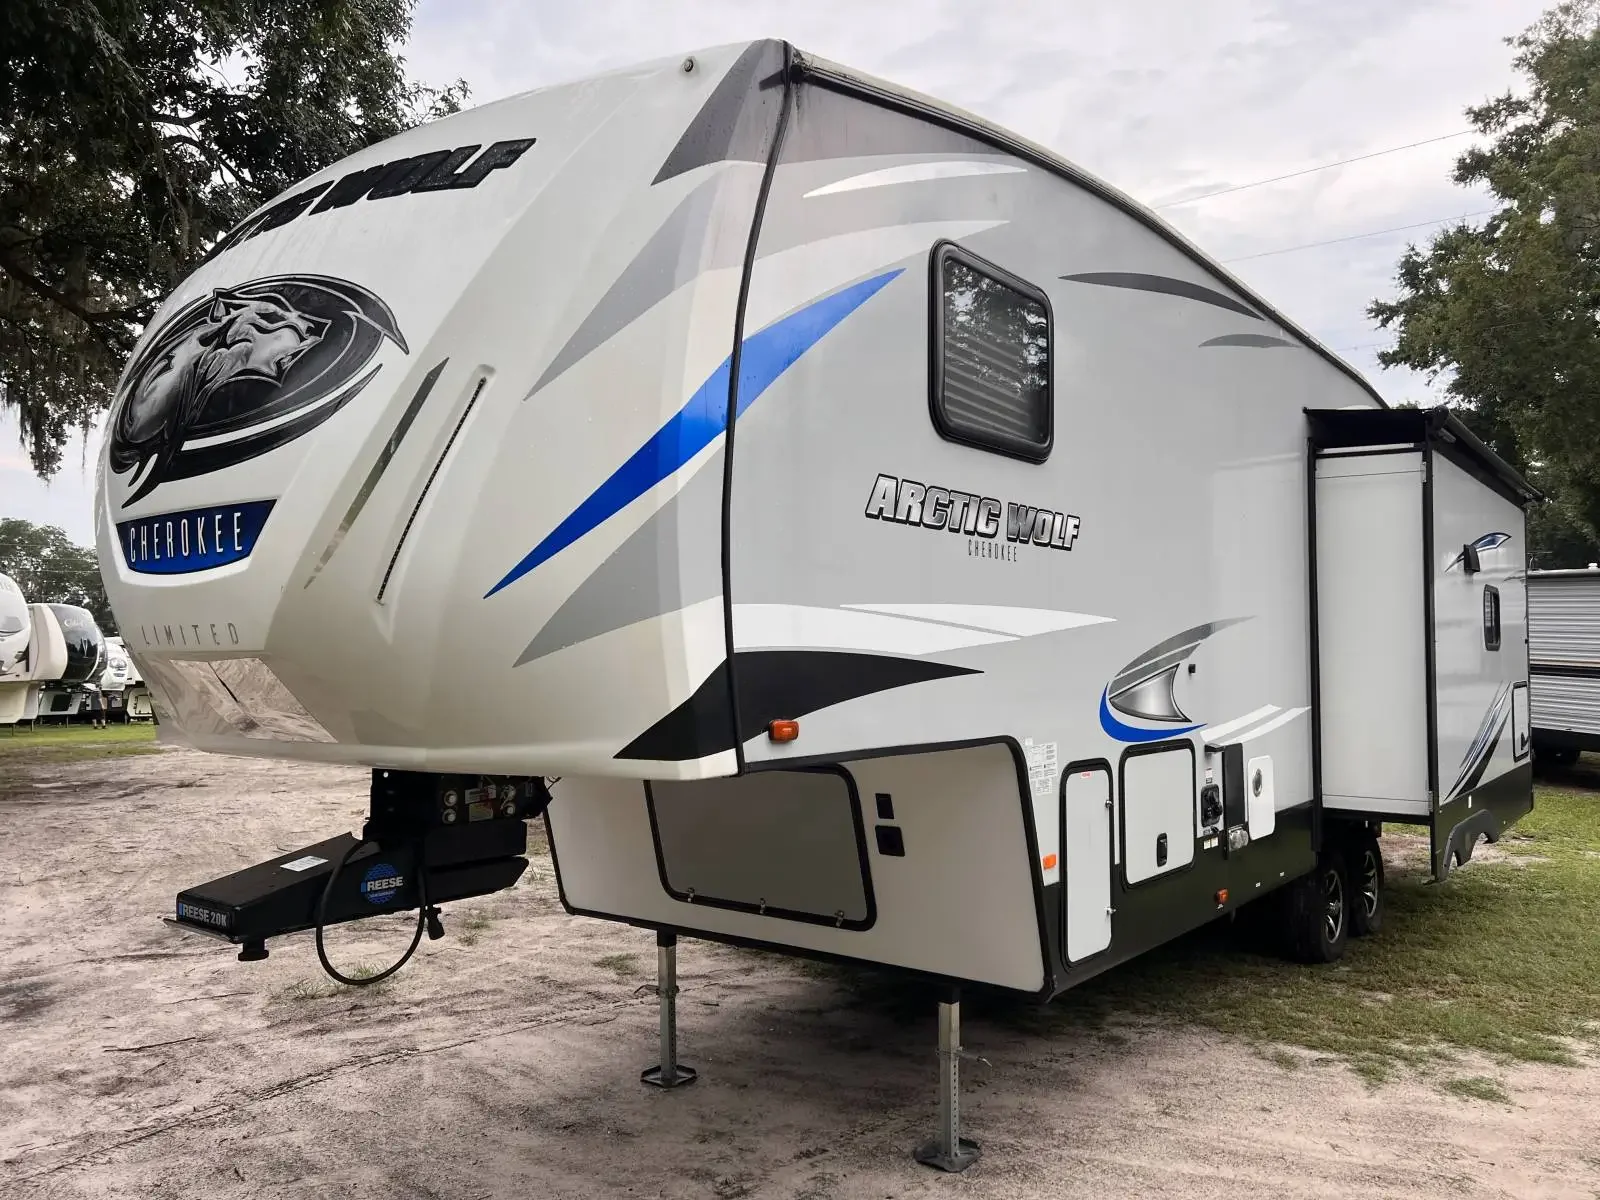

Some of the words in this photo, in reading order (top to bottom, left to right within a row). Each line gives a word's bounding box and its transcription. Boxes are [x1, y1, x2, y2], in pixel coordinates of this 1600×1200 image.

[865, 473, 1002, 539] ARCTIC
[1007, 501, 1081, 551] WOLF
[130, 512, 243, 563] CHEROKEE
[967, 539, 1018, 563] CHEROKEE
[141, 622, 240, 646] LIMITED
[367, 876, 404, 892] REESE
[182, 903, 210, 923] REESE
[210, 911, 228, 928] 20K
